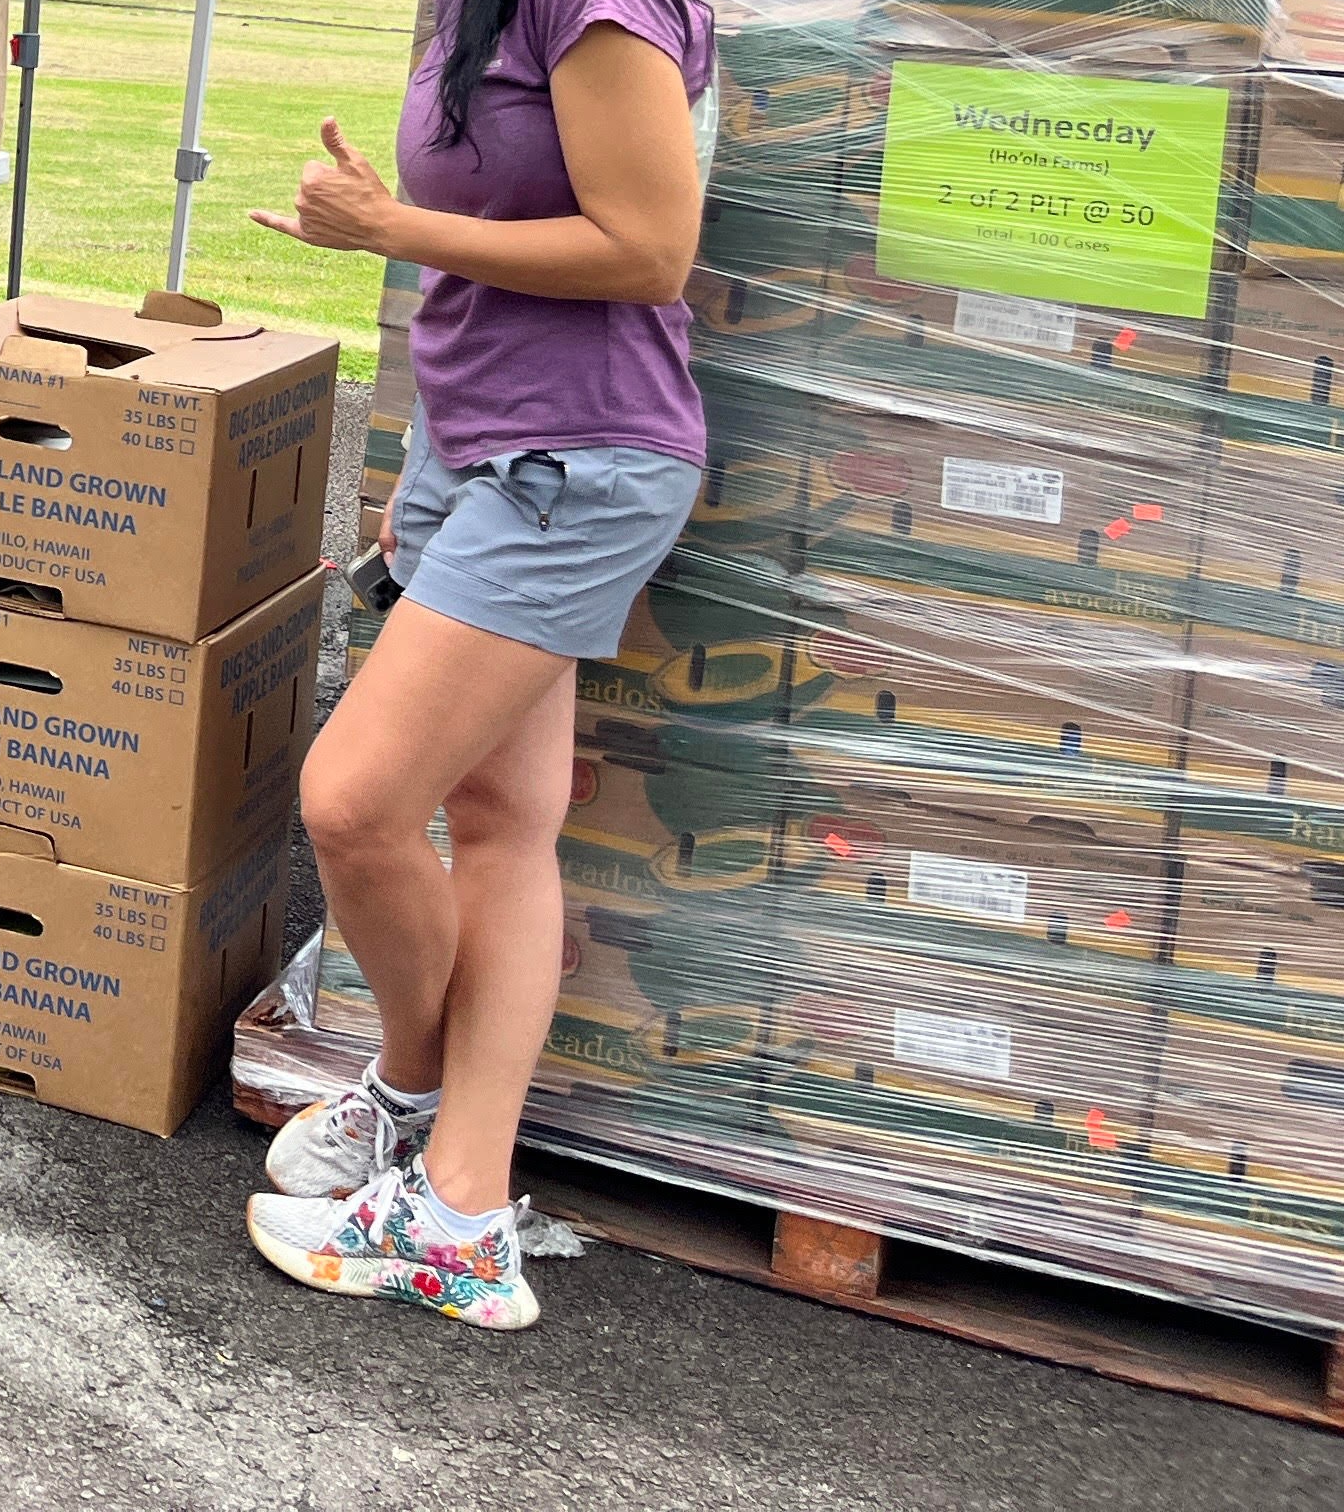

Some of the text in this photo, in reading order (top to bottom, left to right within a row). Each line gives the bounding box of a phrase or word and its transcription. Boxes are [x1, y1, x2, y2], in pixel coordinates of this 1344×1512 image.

[953, 103, 1155, 152] Wednesday
[1053, 156, 1110, 176] Farms)
[938, 185, 1154, 226] 2 of 2 PLT @ 50
[975, 225, 1110, 253] Total 100 Cases
[47, 375, 65, 389] #1
[138, 389, 203, 413] NET WT.
[123, 410, 176, 430] 35 LBS
[122, 432, 174, 452] 40 LBS
[69, 472, 166, 507] GROWN
[31, 498, 136, 535] BANANA
[33, 538, 90, 560] HAWAII
[49, 562, 73, 577] OF
[74, 565, 106, 586] USA
[128, 639, 191, 662] NET WT.
[114, 659, 166, 679] 35 LBS
[112, 681, 164, 701] 40 LBS
[43, 715, 140, 753] GROWN
[6, 738, 111, 780] BANANA
[9, 778, 66, 804] HAWAII
[25, 804, 47, 819] OF
[49, 808, 81, 830] USA
[109, 884, 141, 900] NET
[95, 903, 147, 925] 35 LBS
[94, 925, 146, 947] 40 LBS
[25, 957, 121, 997] GROWN
[6, 1044, 27, 1061] OF
[30, 1049, 62, 1071] USA
